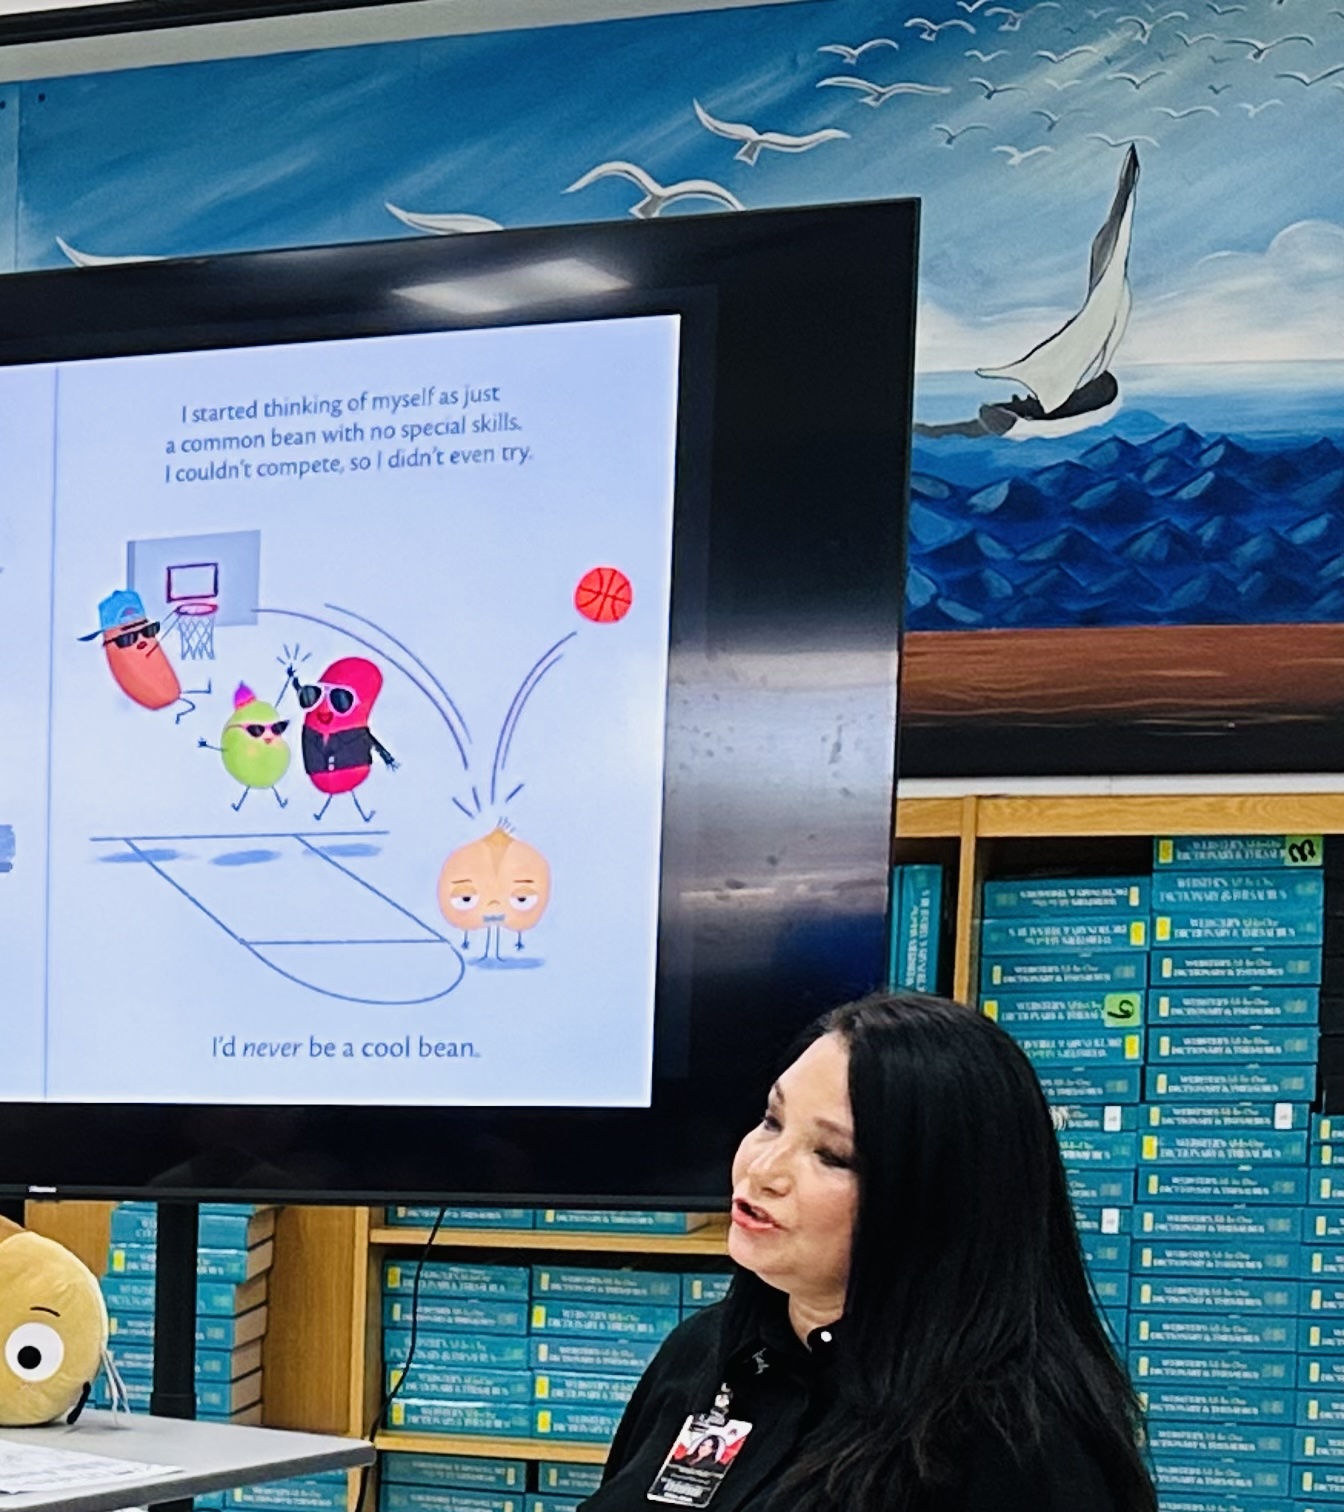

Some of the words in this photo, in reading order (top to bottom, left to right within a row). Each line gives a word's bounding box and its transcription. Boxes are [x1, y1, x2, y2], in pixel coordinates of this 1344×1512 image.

[181, 406, 187, 423] I
[191, 401, 258, 423] started
[263, 396, 343, 419] thinking
[346, 393, 369, 411] of
[372, 387, 435, 413] myself
[439, 390, 460, 406] as
[462, 385, 500, 407] just
[165, 439, 176, 454] a
[181, 432, 266, 452] common
[271, 427, 317, 447] bean
[322, 424, 366, 444] with
[370, 423, 396, 440] no
[400, 417, 466, 441] special
[471, 413, 523, 434] skills.
[165, 465, 170, 484] I
[175, 459, 252, 483] couldn't
[257, 456, 345, 479] compete,
[349, 456, 371, 472] so
[376, 453, 382, 471] I
[387, 448, 445, 469] didn't
[450, 448, 497, 465] even
[501, 444, 534, 466] try.
[212, 1036, 237, 1059] I'd
[242, 1040, 302, 1058] never
[309, 1036, 336, 1058] be
[342, 1041, 355, 1058] a
[361, 1036, 411, 1058] cool
[418, 1036, 481, 1058] bean.
